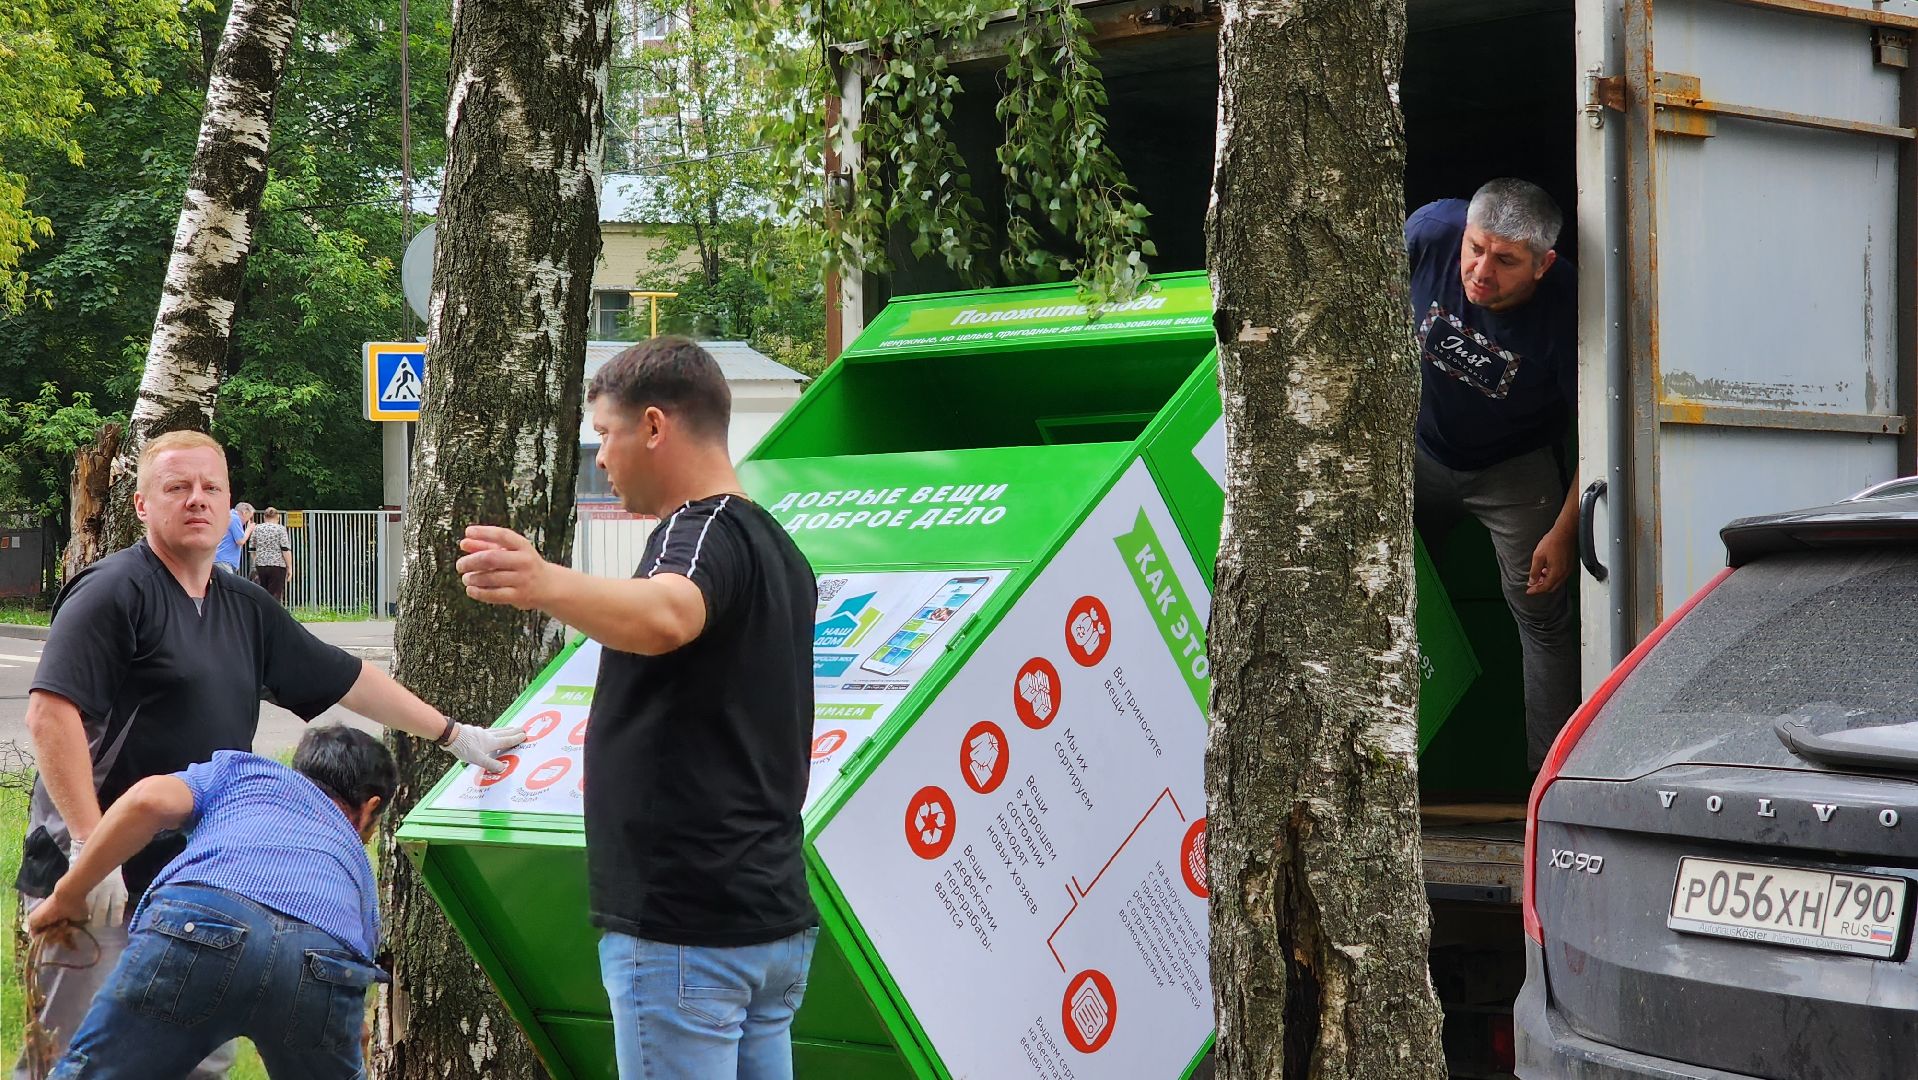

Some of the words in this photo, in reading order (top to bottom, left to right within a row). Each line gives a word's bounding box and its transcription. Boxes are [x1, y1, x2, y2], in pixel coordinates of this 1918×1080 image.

[879, 336, 938, 348] ненужные,
[956, 331, 993, 342] целые,
[995, 327, 1056, 339] пригодные
[1058, 324, 1083, 334] для
[1084, 318, 1173, 331] использования
[1173, 316, 1208, 325] вещи
[951, 304, 1088, 326] Положите
[1440, 335, 1492, 367] Just
[769, 487, 907, 513] ДОБРЫЕ
[908, 483, 1009, 505] ВЕЩИ
[783, 508, 913, 534] ДОБРОЕ
[908, 506, 1007, 530] ДЕЛО
[1134, 543, 1177, 616] КАК
[1170, 614, 1209, 680] ЭТО
[1104, 679, 1125, 716] вещи
[1113, 666, 1127, 689] Вы
[1124, 689, 1162, 758] приносите
[1063, 727, 1078, 754] Мы
[1076, 753, 1089, 773] их
[1026, 775, 1048, 815] Вещи
[1054, 741, 1093, 811] сортируем
[1016, 788, 1024, 799] в
[1022, 800, 1057, 861] хорошем
[1657, 790, 1899, 828] VOLVO
[996, 812, 1029, 867] находят
[1006, 801, 1045, 869] состоянии
[963, 844, 987, 883] Вещи
[985, 884, 993, 894] с
[986, 825, 1012, 869] новых
[1010, 868, 1038, 915] хозяев
[1548, 847, 1605, 875] XC90
[934, 882, 964, 929] ваются
[944, 870, 993, 953] перерабаты-
[953, 859, 998, 932] дефектами
[1152, 879, 1178, 925] продажи
[1177, 924, 1197, 958] вещей
[1155, 860, 1165, 878] На
[1163, 877, 1199, 938] вырученные
[1833, 879, 1893, 923] 790
[1118, 909, 1164, 989] возможностями
[1130, 908, 1176, 987] ограниченными
[1132, 890, 1174, 962] реабилитации
[1171, 961, 1184, 981] для
[1182, 981, 1201, 1010] детей
[1140, 879, 1179, 948] приобретаем
[1177, 948, 1203, 992] средства
[1841, 922, 1870, 937] RUS
[1020, 1037, 1043, 1072] вещей
[1027, 1027, 1038, 1042] на
[1035, 1015, 1061, 1058] Выдаем
